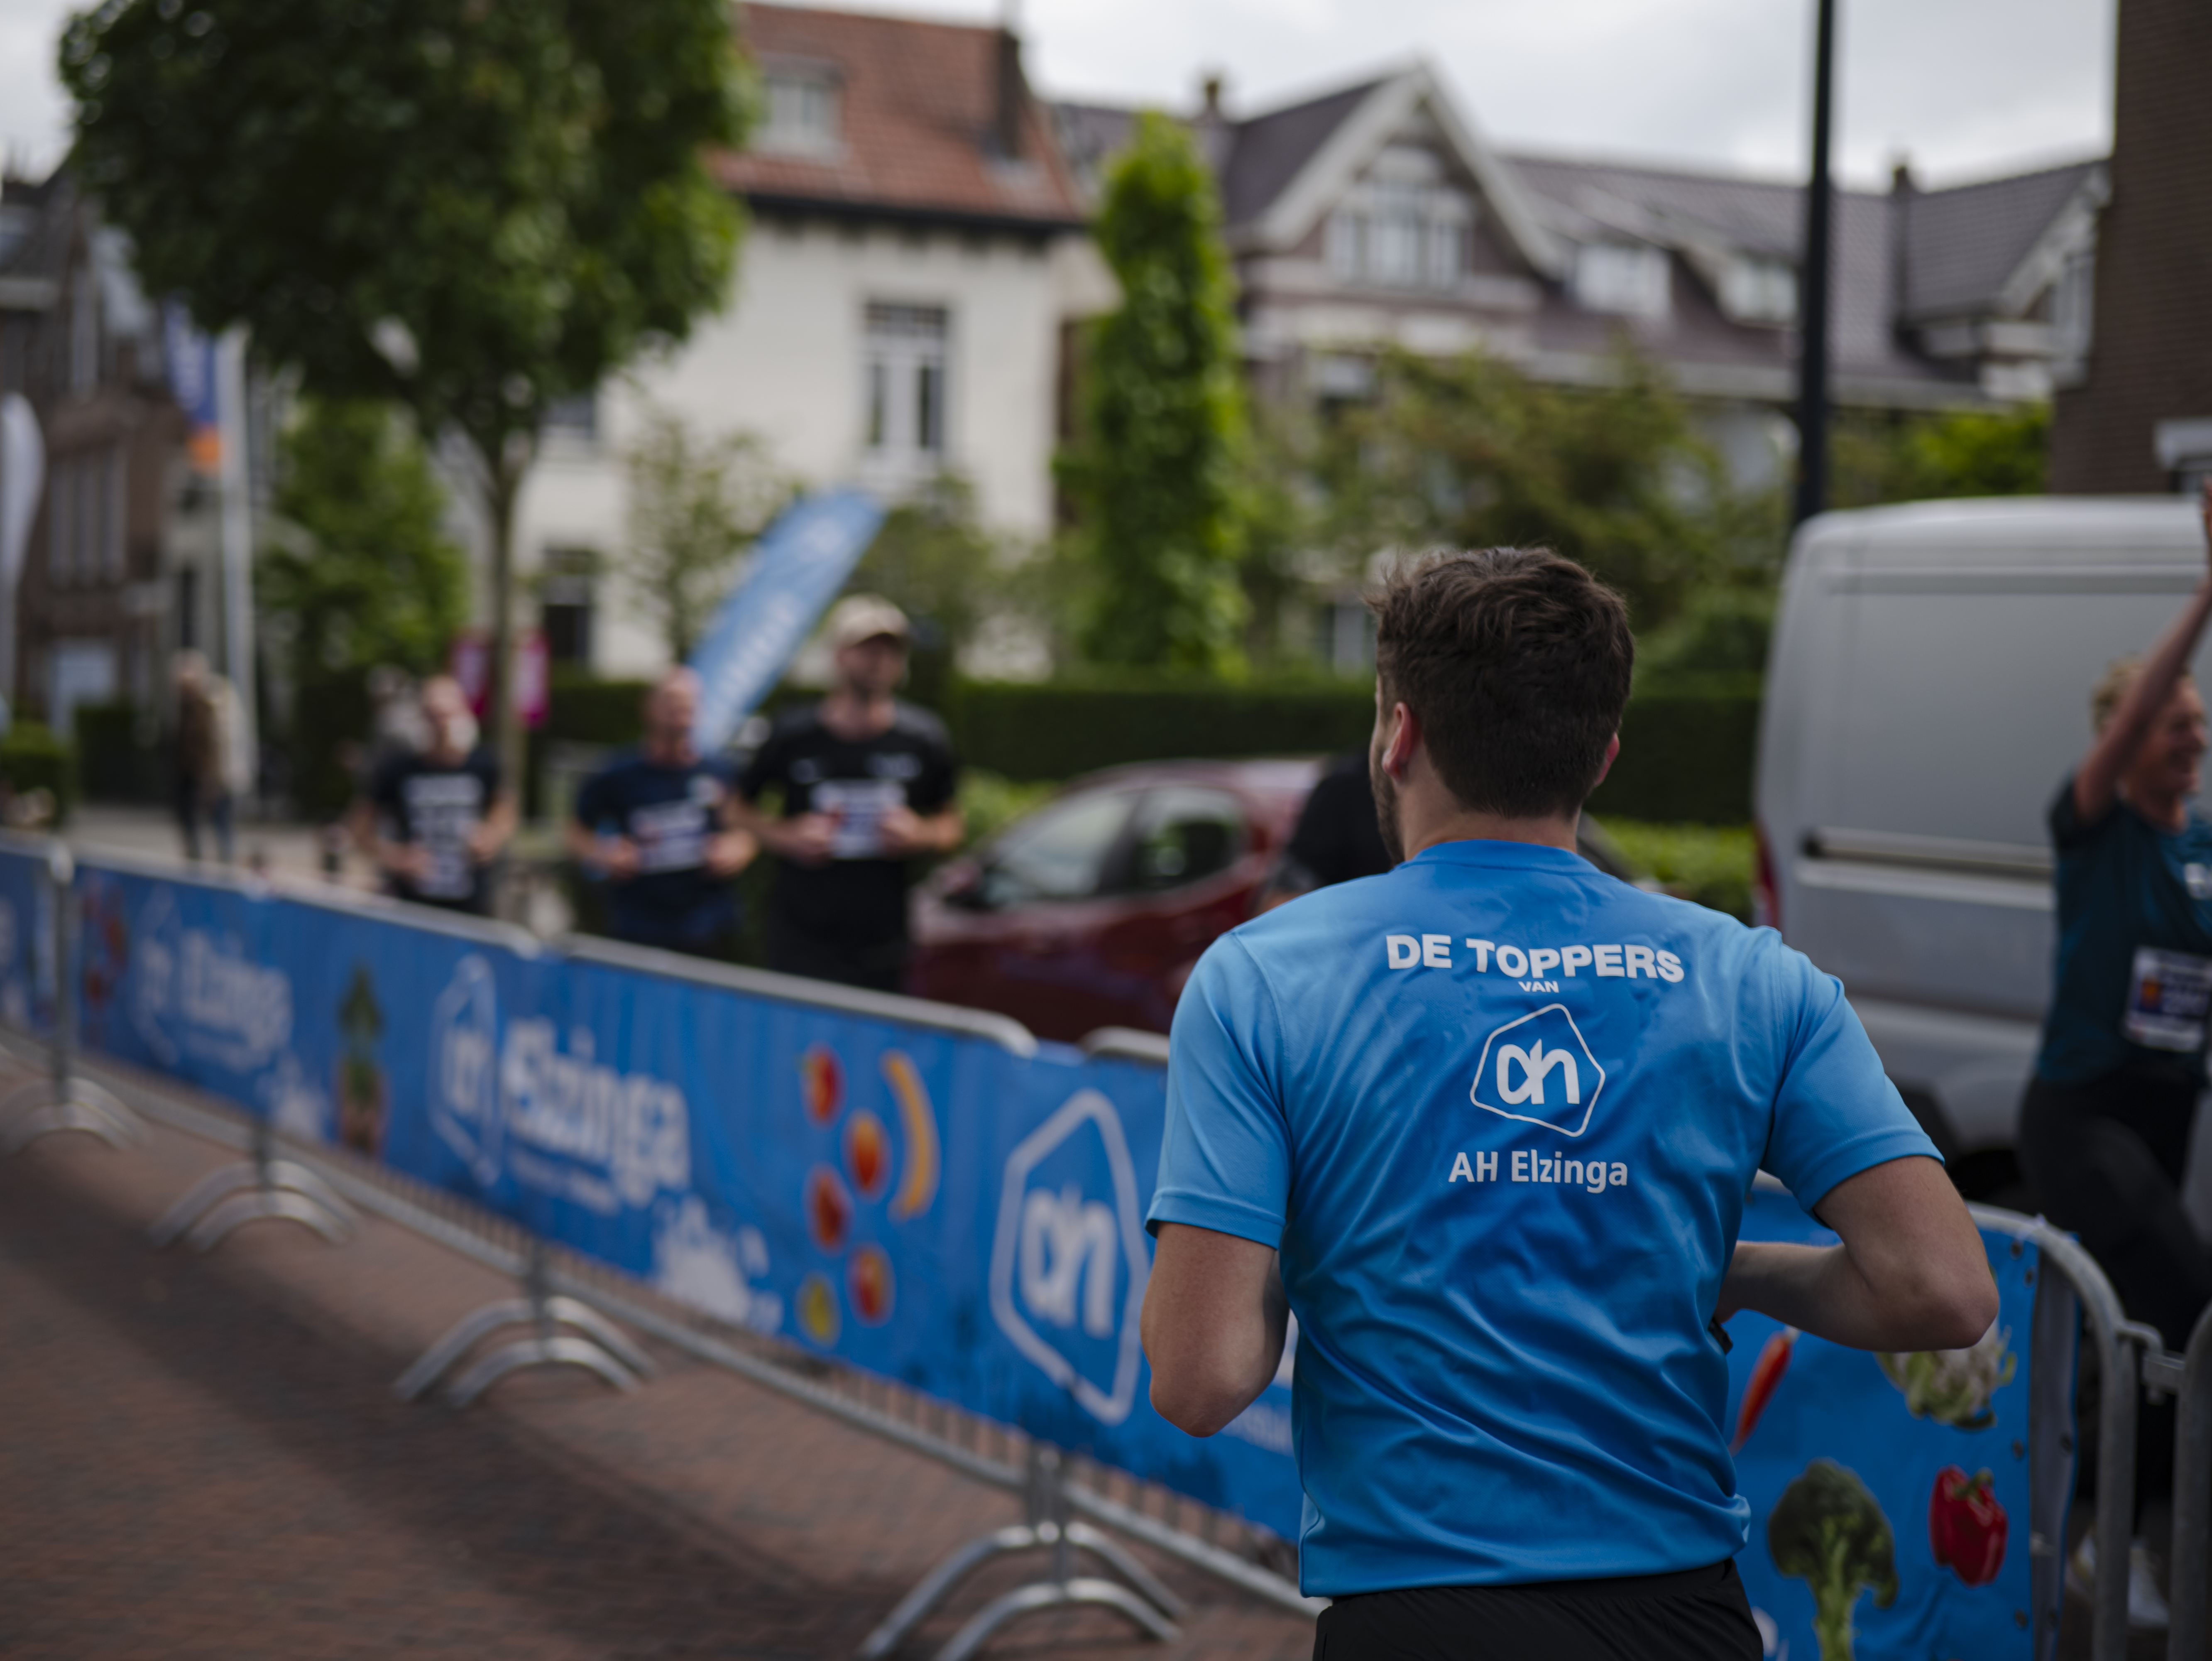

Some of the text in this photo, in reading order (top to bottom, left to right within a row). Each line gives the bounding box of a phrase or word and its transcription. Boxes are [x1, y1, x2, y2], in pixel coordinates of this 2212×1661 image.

[1386, 933, 1685, 983] DE TOPPERS
[1518, 980, 1559, 993] VAN
[1448, 1149, 1628, 1194] AH Elzinga
